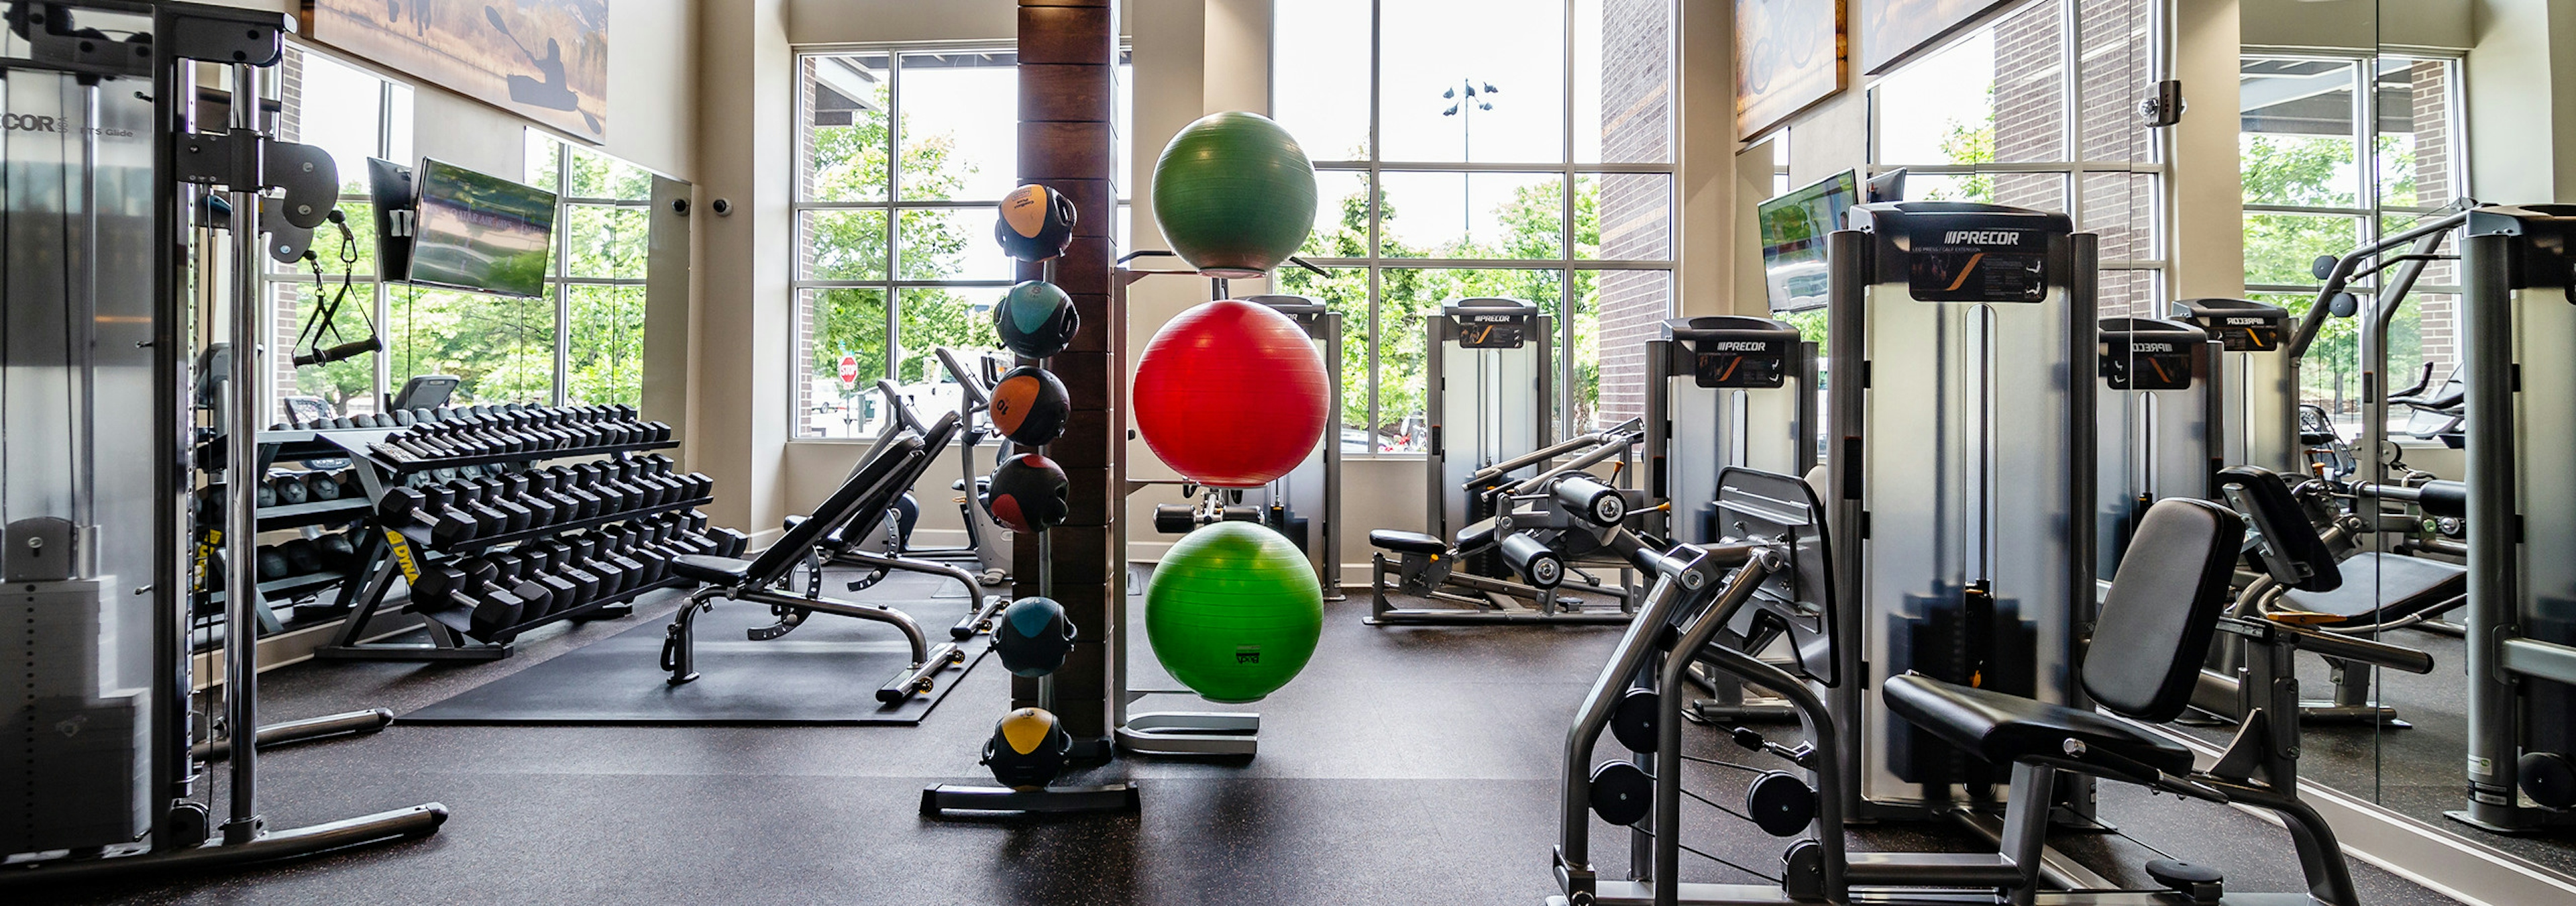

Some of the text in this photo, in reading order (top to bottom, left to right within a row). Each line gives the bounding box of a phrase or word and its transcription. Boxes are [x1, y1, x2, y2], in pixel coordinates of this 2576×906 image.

[0, 113, 56, 132] COR
[105, 128, 133, 138] Glide
[1955, 231, 2020, 246] PRECOR
[1725, 342, 1766, 351] PRECOR
[841, 365, 857, 376] STOP
